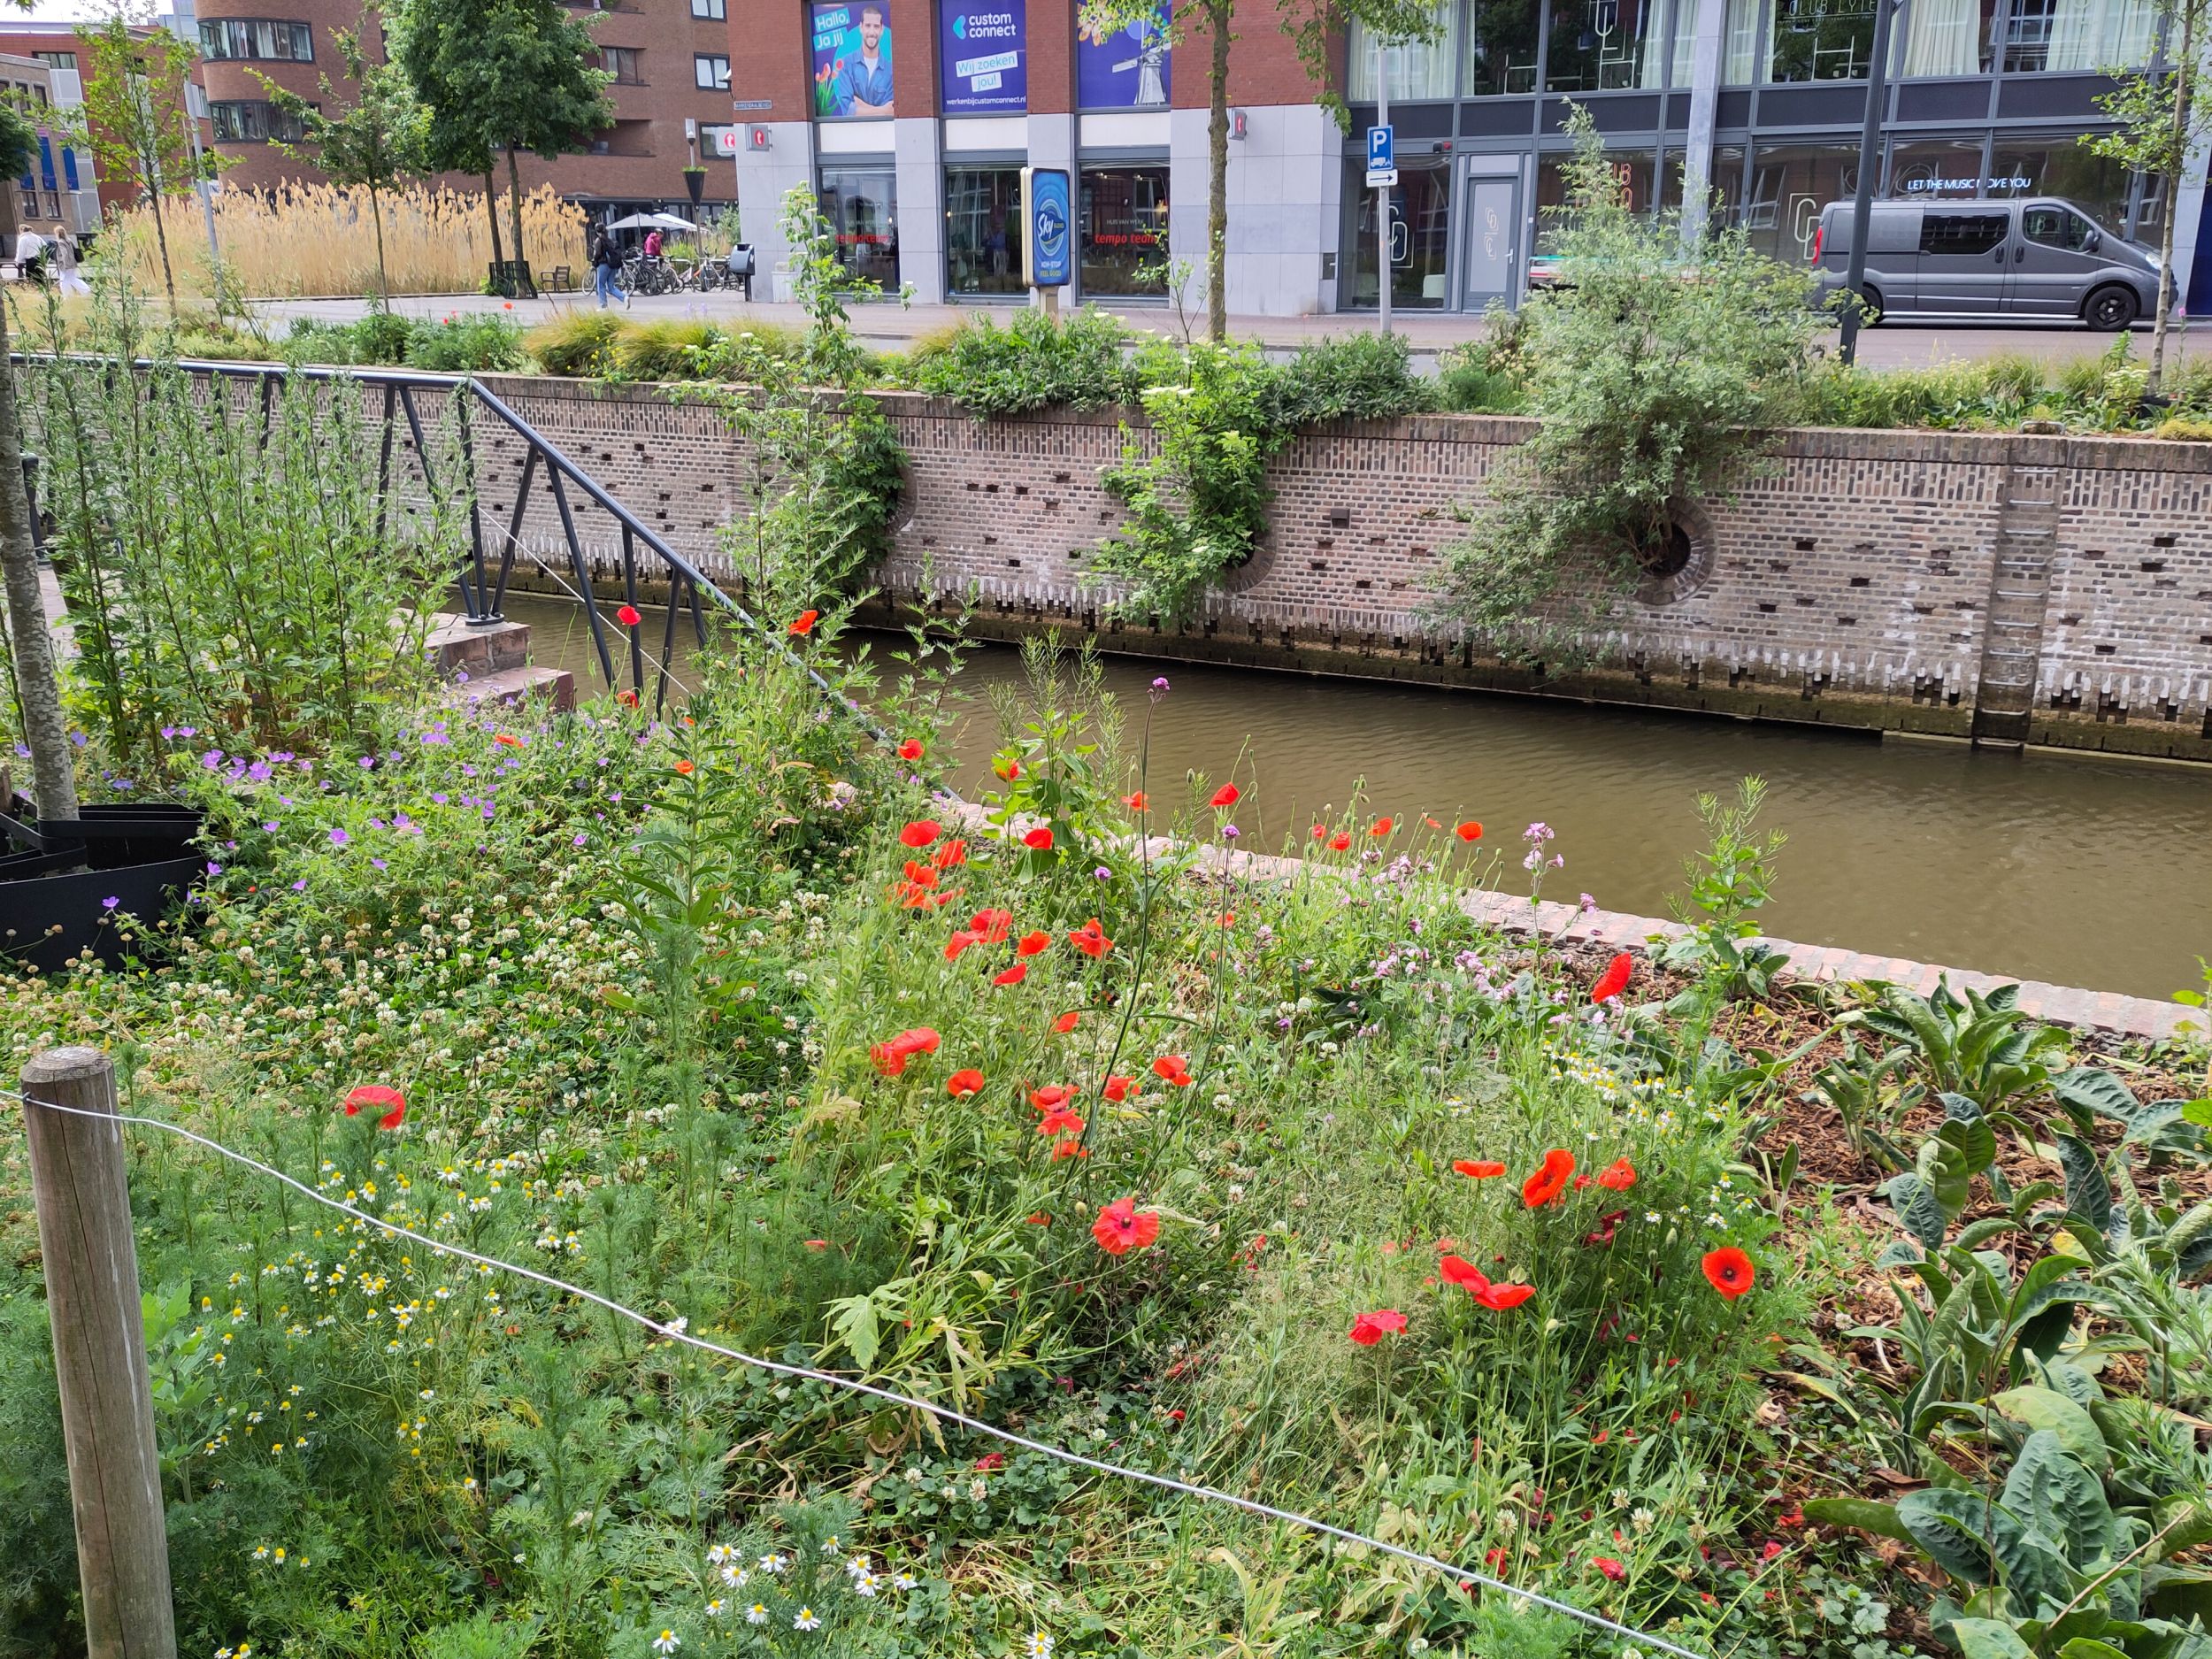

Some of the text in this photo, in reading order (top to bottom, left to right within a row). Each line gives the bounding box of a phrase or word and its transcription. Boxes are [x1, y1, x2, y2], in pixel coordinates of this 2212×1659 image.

[816, 12, 849, 30] Hallo,
[969, 12, 1012, 27] custom
[818, 28, 844, 49] Ja jij
[969, 24, 1017, 38] connect
[957, 55, 1015, 74] Wij zoeken
[978, 74, 996, 90] jou!
[946, 96, 1026, 106] werkenbijcustomconnect.nl
[1372, 130, 1387, 153] P
[1908, 178, 2032, 190] LET THE MUSIC OVE YOU
[1038, 212, 1054, 240] Sky
[1094, 234, 1127, 247] tempo
